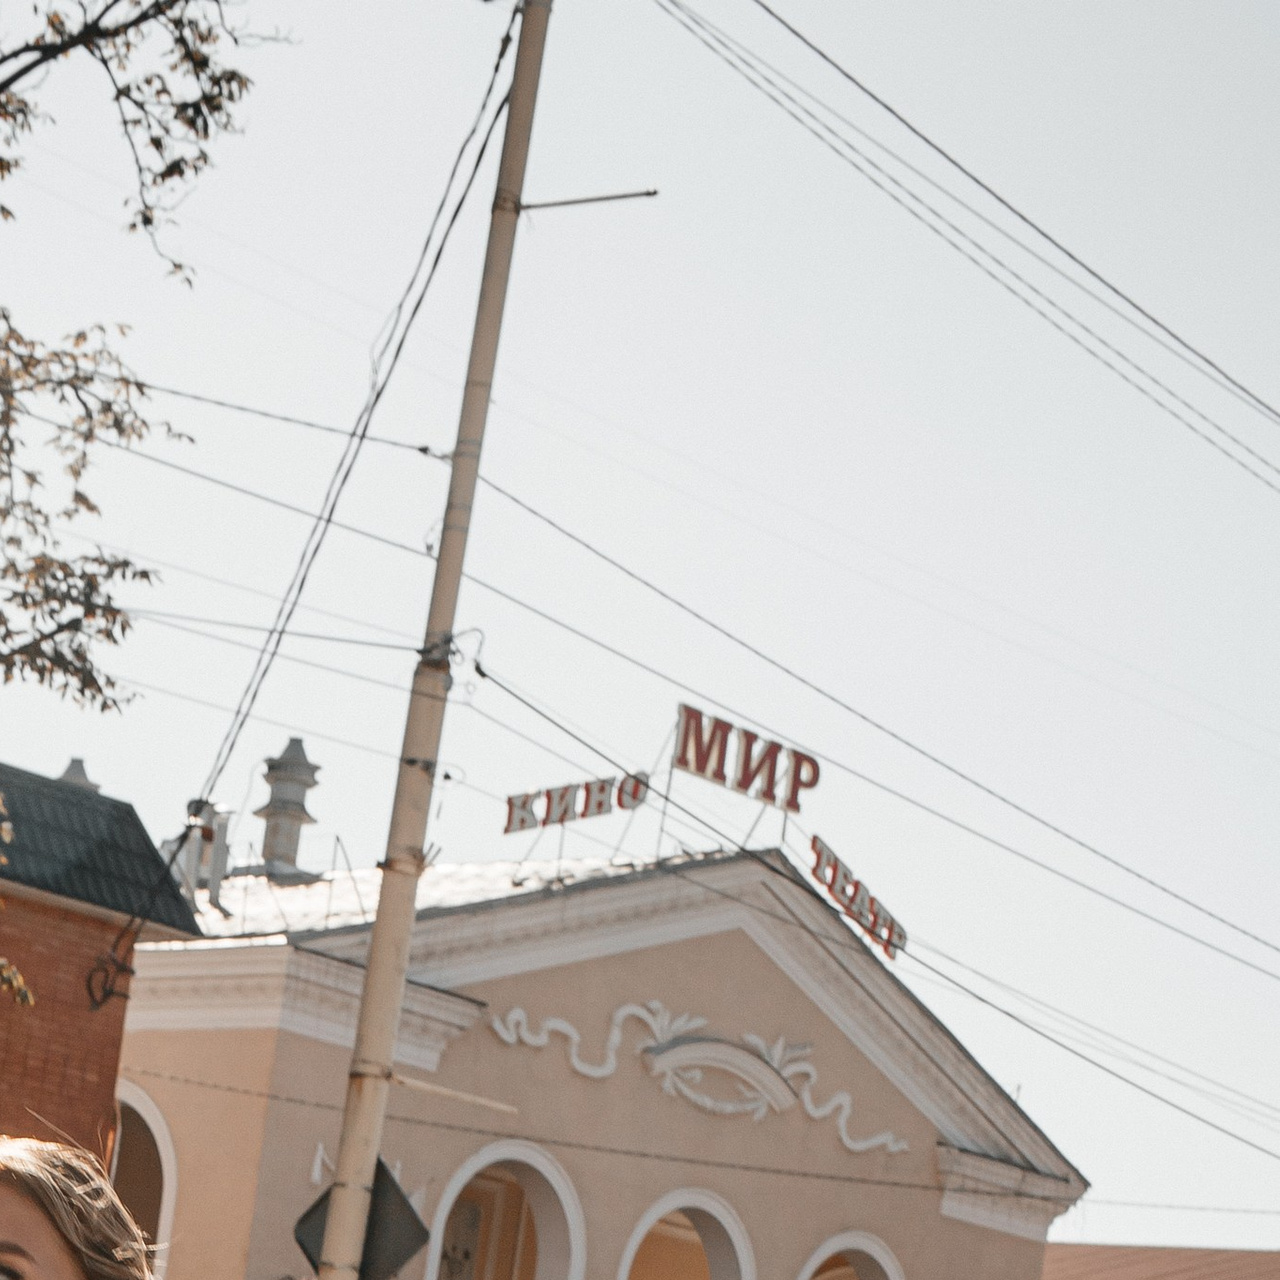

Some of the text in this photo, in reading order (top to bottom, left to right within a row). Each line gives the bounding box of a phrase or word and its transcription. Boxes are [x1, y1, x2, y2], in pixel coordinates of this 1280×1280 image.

[503, 701, 908, 961] КИНО МИР ТЕАТР
